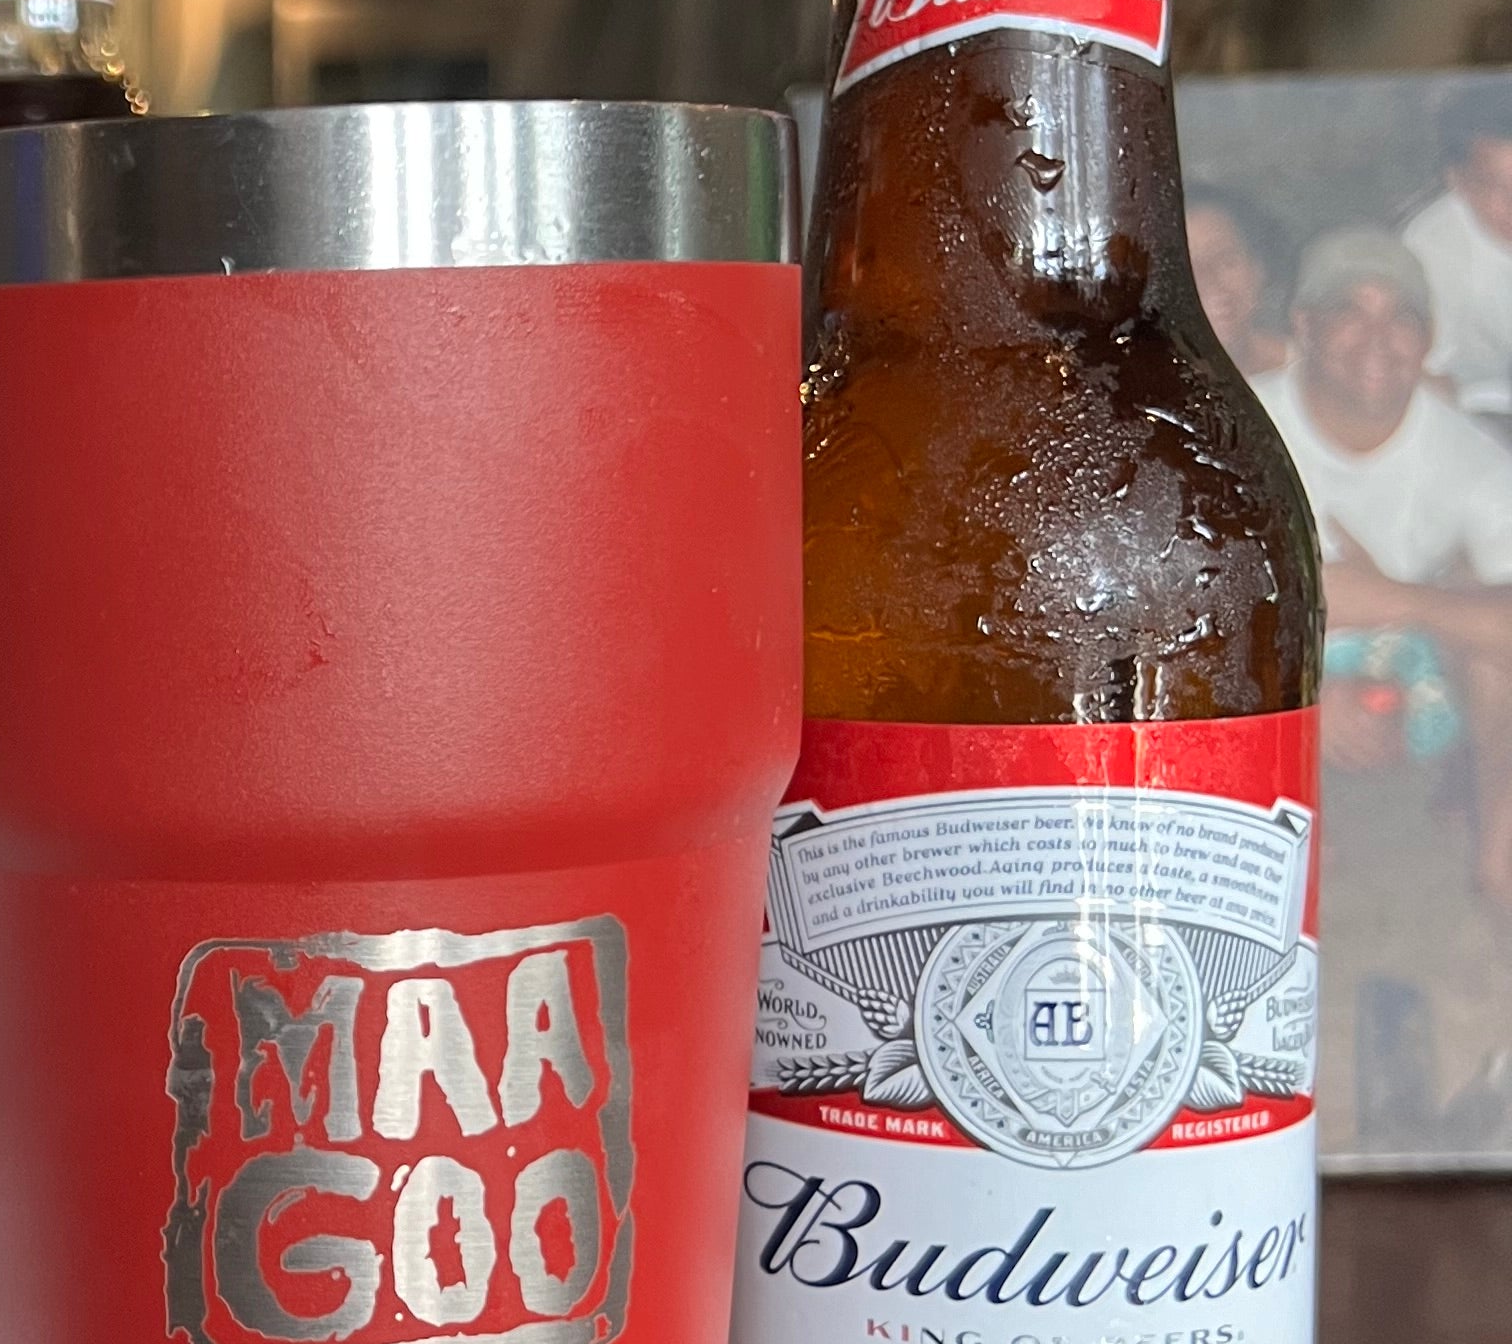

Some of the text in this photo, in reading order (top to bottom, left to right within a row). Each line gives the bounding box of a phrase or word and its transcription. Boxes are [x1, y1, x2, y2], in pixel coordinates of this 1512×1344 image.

[798, 846, 824, 864] This
[828, 840, 839, 855] is
[843, 836, 865, 852] the
[869, 827, 929, 849] famous
[936, 815, 1030, 837] Budweiser
[1034, 814, 1076, 830] beer.
[1176, 822, 1194, 837] no
[802, 869, 819, 887] by
[823, 862, 849, 880] any
[855, 851, 896, 872] other
[902, 842, 962, 863] brewer
[969, 836, 1020, 855] which
[1027, 836, 1072, 852] costs
[808, 877, 876, 905] exclusive
[882, 862, 981, 888] Beechwood
[1198, 872, 1208, 883] a
[812, 905, 839, 927] and
[843, 906, 852, 918] a
[856, 886, 956, 916] drinkability
[962, 882, 994, 900] you
[1000, 880, 1033, 896] will
[1038, 879, 1074, 897] find
[757, 988, 823, 1024] WORLD
[230, 950, 594, 1142] MAA
[755, 1028, 827, 1050] NOWNED
[967, 1055, 1005, 1099] AFRICA
[1124, 1060, 1153, 1098] ASIA
[819, 1106, 944, 1138] TRADE MARK
[1026, 1131, 1102, 1148] AMERICA
[214, 1145, 602, 1342] GOO
[743, 1160, 1307, 1308] Budweiser
